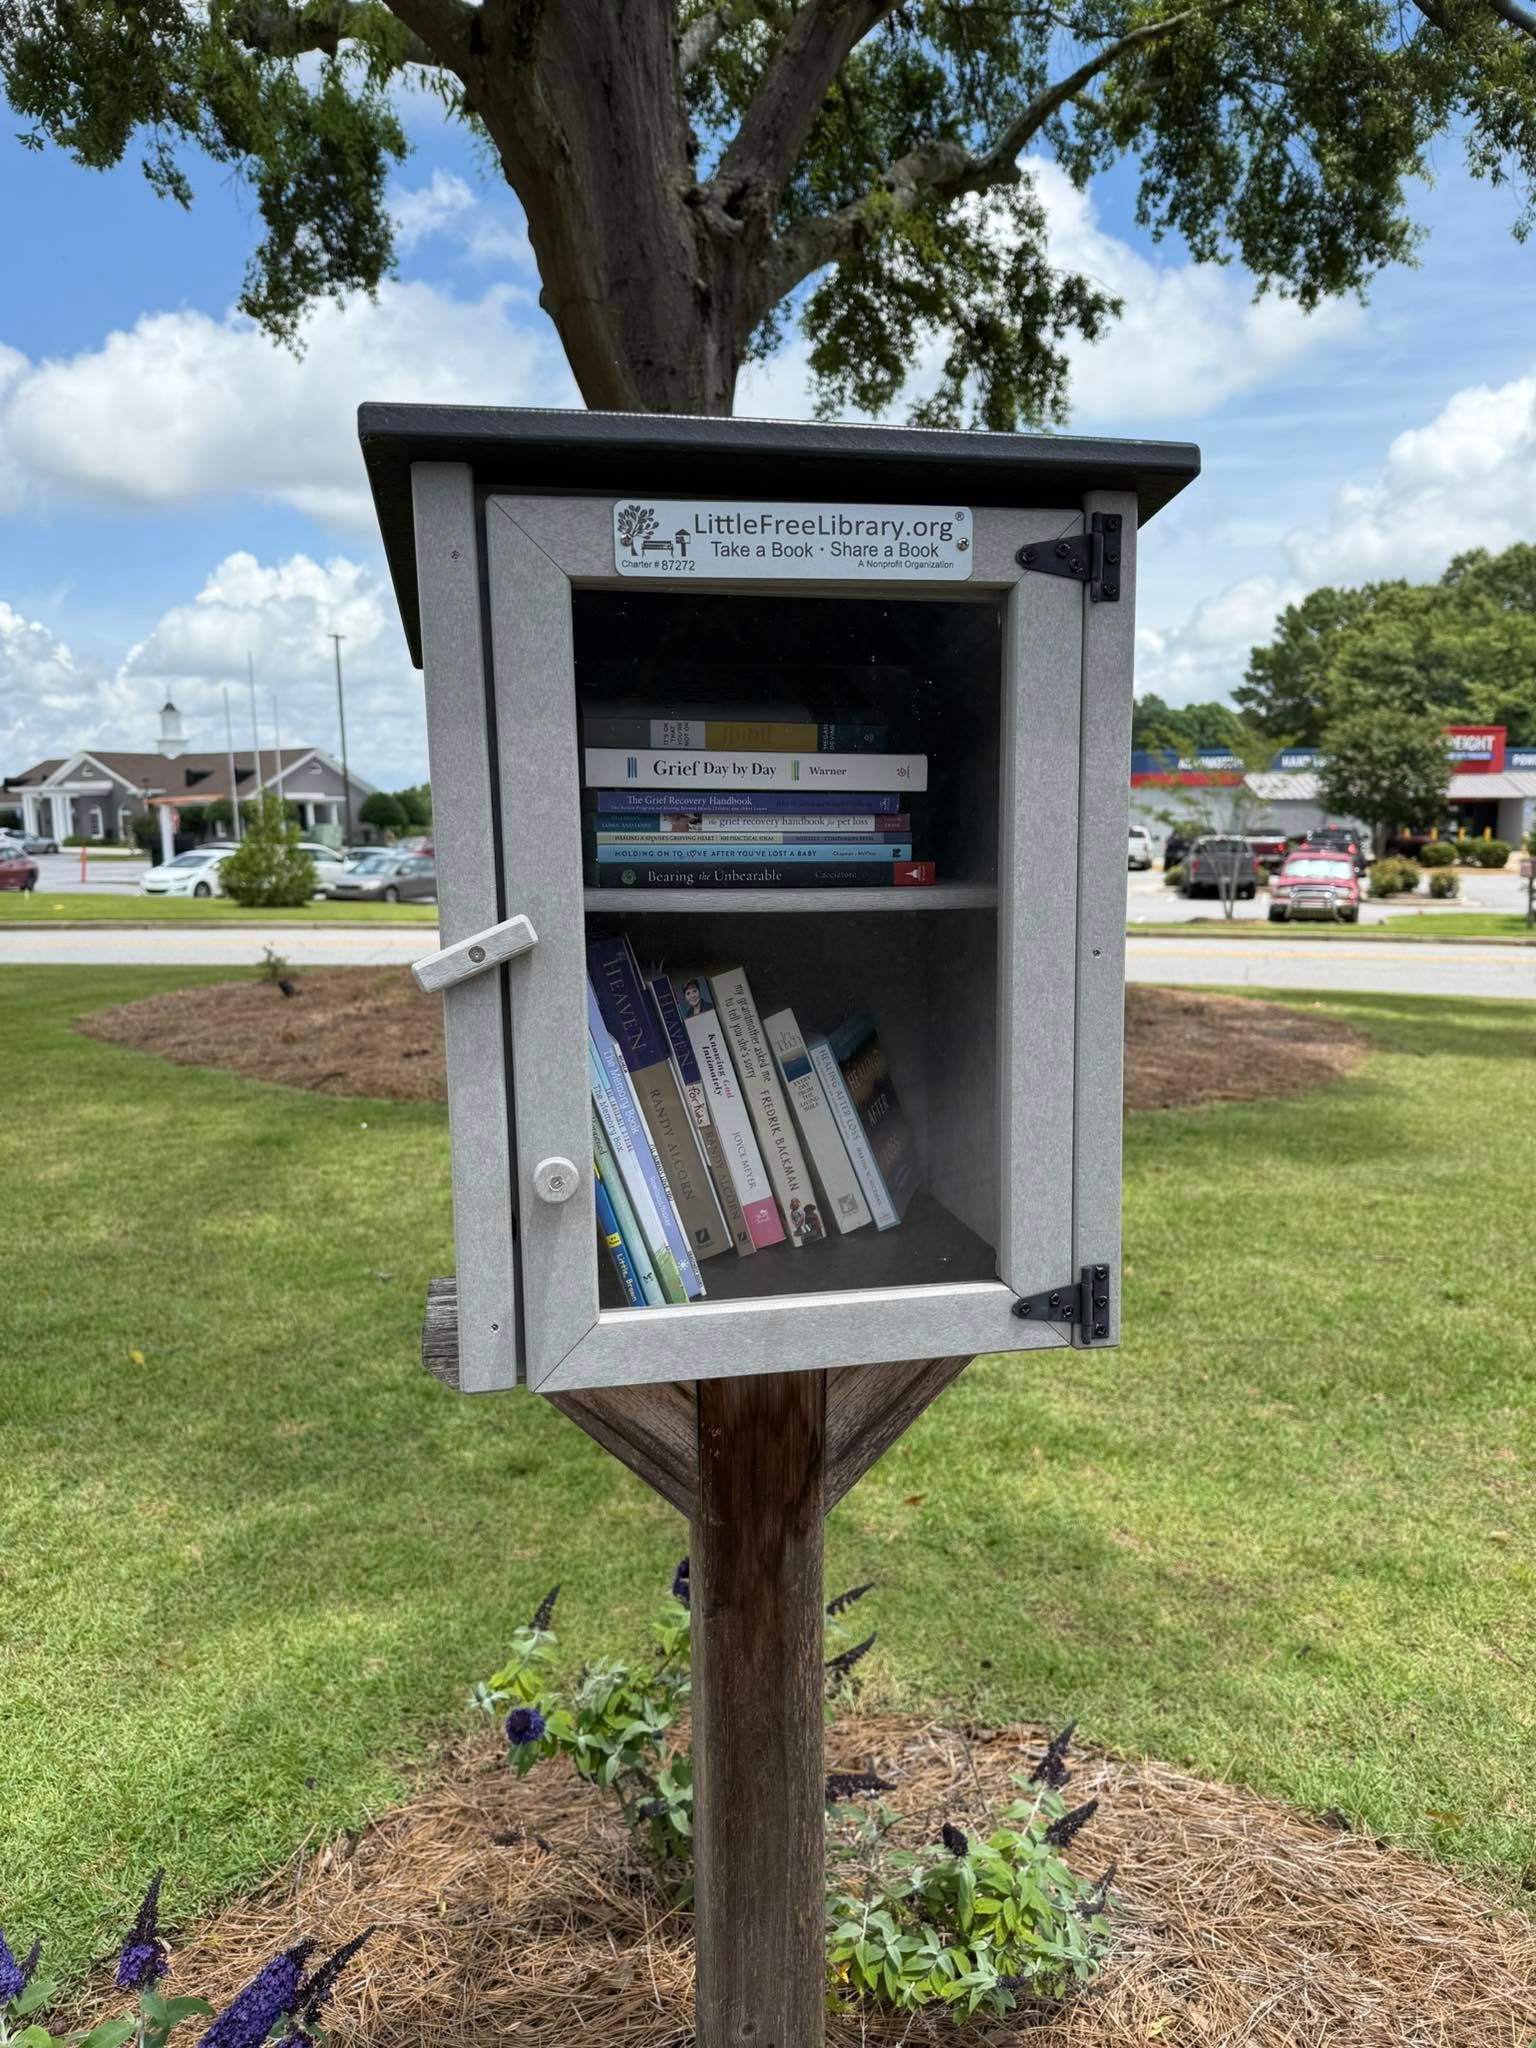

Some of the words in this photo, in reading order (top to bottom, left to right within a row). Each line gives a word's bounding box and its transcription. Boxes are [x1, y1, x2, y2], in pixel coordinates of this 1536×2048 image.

[695, 513, 953, 541] LittleFreeLibrary.org
[711, 541, 753, 558] Take
[756, 545, 765, 558] a
[772, 541, 813, 558] Book
[830, 541, 880, 558] Share
[884, 546, 893, 558] a
[899, 542, 939, 559] Book
[621, 559, 654, 569] Charter
[661, 560, 696, 572] 87272
[858, 560, 864, 568] A
[866, 560, 903, 569] Nonprofit
[904, 561, 954, 570] Organization
[653, 760, 701, 776] Grief
[704, 761, 729, 779] Day
[733, 763, 747, 779] by
[752, 763, 777, 780] Day
[809, 766, 847, 776] Warner
[626, 795, 643, 805] The
[645, 795, 667, 805] Grief
[669, 796, 706, 807] Recovery
[709, 796, 752, 806] Handbook
[719, 816, 741, 829] grief
[742, 817, 780, 829] recovery
[782, 815, 825, 826] handbook
[837, 817, 850, 829] pet
[852, 816, 869, 825] loss
[648, 870, 694, 886] Bearing
[698, 872, 711, 882] the
[714, 869, 783, 882] Unbearable
[734, 983, 744, 997] my
[604, 958, 647, 1051] HEAVEN
[725, 998, 733, 1007] to
[728, 1007, 740, 1022] tell
[737, 996, 760, 1046] grandmother
[659, 993, 693, 1068] HEAVEN
[730, 1023, 742, 1038] you
[736, 1037, 751, 1057] she's
[754, 1045, 767, 1068] asked
[701, 1045, 724, 1096] Intimately
[707, 1033, 725, 1078] Knowing
[722, 1079, 734, 1099] God
[741, 1058, 756, 1080] sorry
[761, 1070, 771, 1083] me
[603, 1048, 616, 1068] The
[610, 1070, 631, 1109] Memory
[625, 1109, 641, 1135] Book
[688, 1085, 700, 1105] for
[819, 1049, 839, 1089] HEALING
[834, 1089, 851, 1119] AFTER
[846, 1118, 861, 1140] LOSS
[593, 1085, 604, 1100] The
[599, 1101, 617, 1137] Memory
[612, 1135, 625, 1153] Box
[649, 1089, 674, 1138] RANDY
[668, 1142, 696, 1201] ALCORN
[705, 1131, 725, 1169] RANDY
[759, 1089, 782, 1135] FREDRIK
[774, 1138, 800, 1192] BACKMAN
[734, 1131, 748, 1160] JOYCE
[742, 1161, 757, 1190] MEYER
